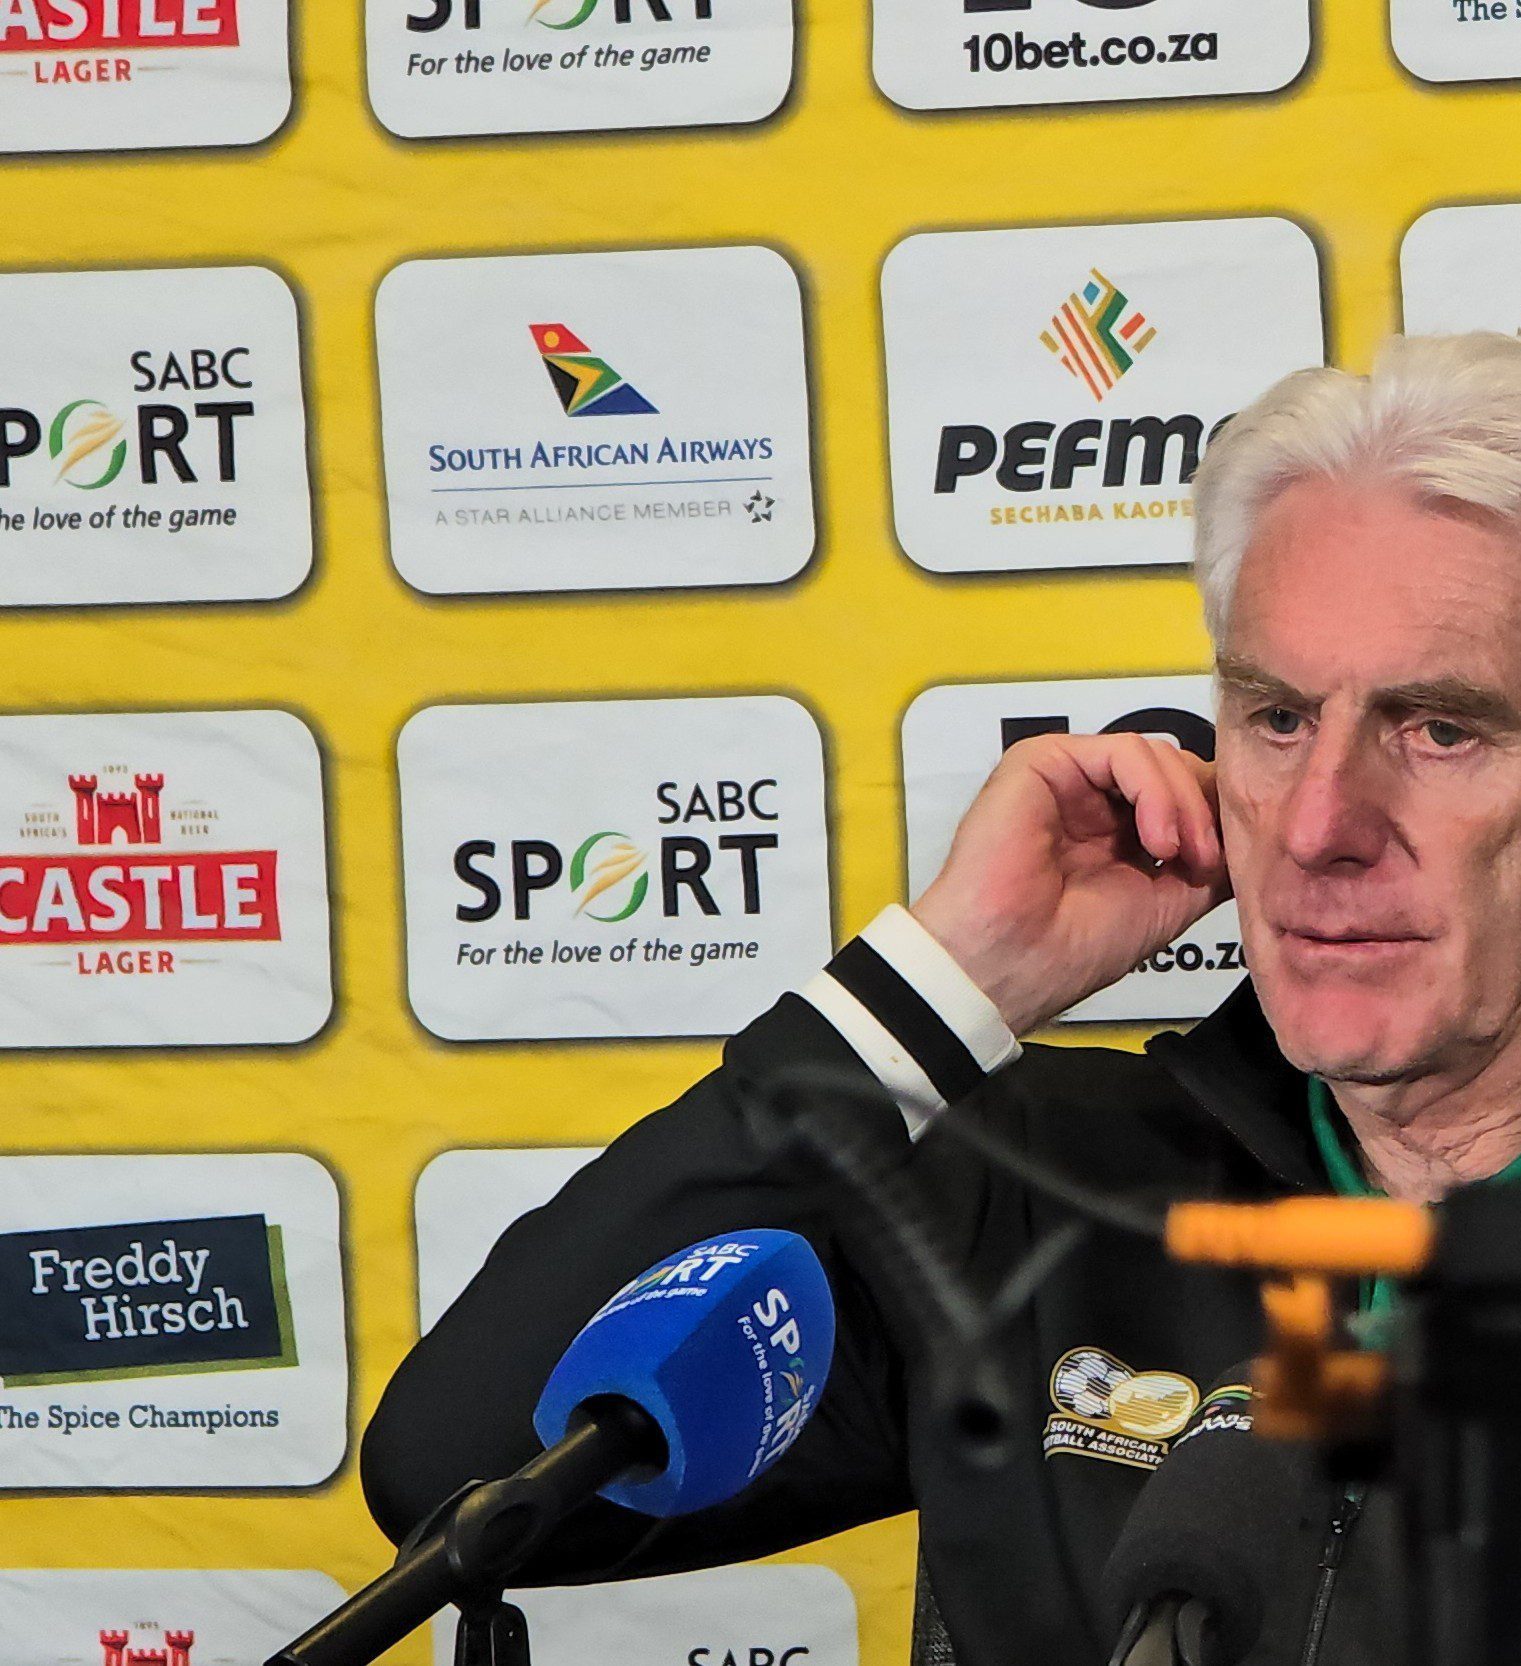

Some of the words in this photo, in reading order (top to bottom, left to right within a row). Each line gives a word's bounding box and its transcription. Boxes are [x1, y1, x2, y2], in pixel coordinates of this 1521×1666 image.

[0, 0, 220, 41] ASTLE
[1453, 0, 1507, 22] The
[407, 53, 448, 76] For
[455, 50, 495, 74] the
[502, 48, 552, 72] love
[559, 44, 590, 69] of
[594, 43, 631, 68] the
[640, 45, 711, 71] game
[963, 31, 1218, 72] 10bet.co.za
[34, 59, 132, 84] LAGER
[130, 347, 252, 392] SABC
[0, 401, 254, 490] PORT
[429, 444, 523, 472] SOUTH
[530, 441, 649, 469] AFRICAN
[657, 436, 773, 465] AIRWAYS
[0, 507, 25, 531] he
[33, 505, 82, 531] love
[89, 504, 116, 529] of
[122, 504, 162, 529] the
[168, 507, 237, 533] game
[435, 510, 448, 526] A
[455, 508, 509, 526] STAR
[518, 502, 626, 524] ALLIANCE
[633, 500, 733, 520] MEMBER
[990, 502, 1105, 525] SECHABA
[1113, 500, 1194, 520] KAOFE
[656, 779, 779, 824] SABC
[453, 831, 779, 923] SPORT
[0, 864, 263, 933] CASTLE
[77, 950, 175, 975] LAGER
[457, 943, 497, 966] For
[503, 940, 543, 965] the
[551, 939, 601, 964] love
[609, 938, 638, 963] of
[643, 937, 683, 962] the
[690, 939, 759, 966] game
[29, 1239, 210, 1295] Freddy
[687, 1243, 760, 1260] SABC
[80, 1286, 249, 1341] Hirsch
[737, 1315, 758, 1341] For
[752, 1342, 768, 1370] the
[48, 1404, 121, 1435] Spice
[129, 1404, 279, 1435] Champions
[1049, 1420, 1096, 1438] SOUTH
[1096, 1431, 1159, 1453] AFRICAN
